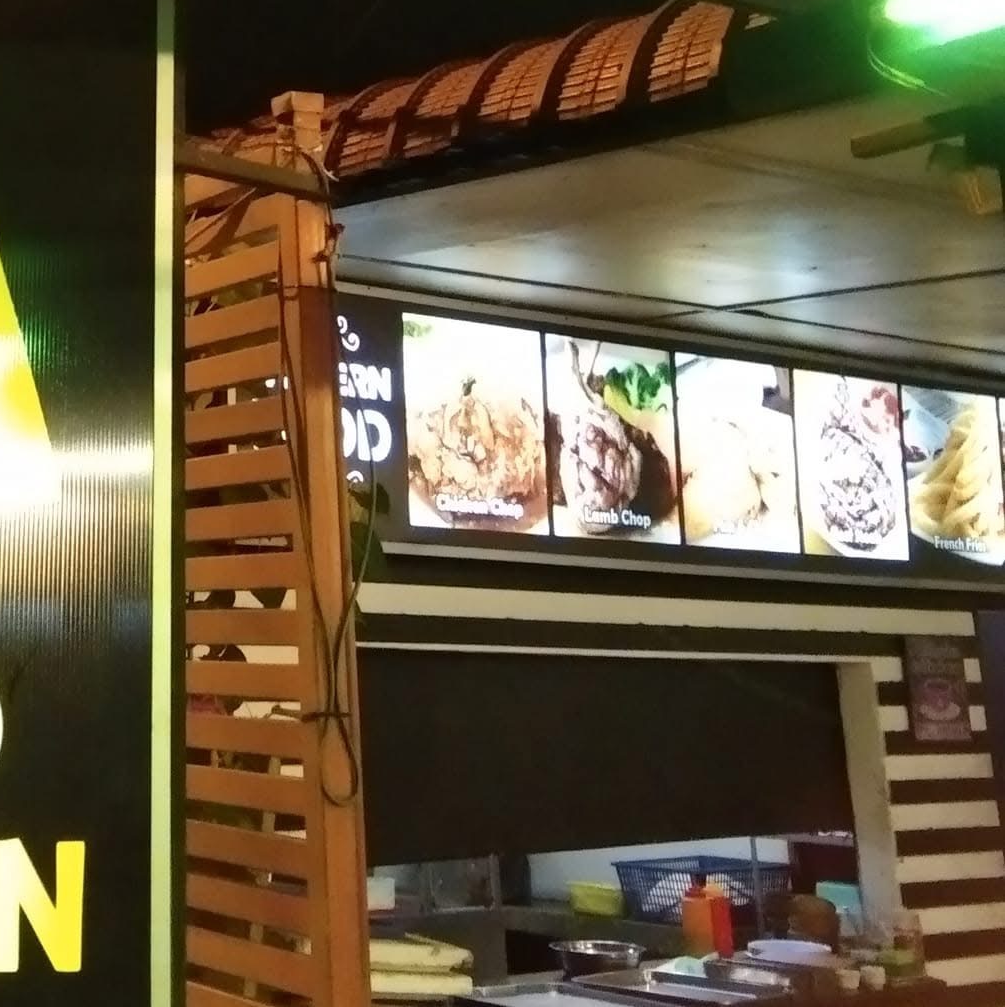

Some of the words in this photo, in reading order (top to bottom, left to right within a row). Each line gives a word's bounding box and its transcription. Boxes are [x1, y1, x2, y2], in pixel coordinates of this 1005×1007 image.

[584, 505, 619, 524] Lamb
[621, 508, 651, 529] Chop
[934, 535, 964, 552] French
